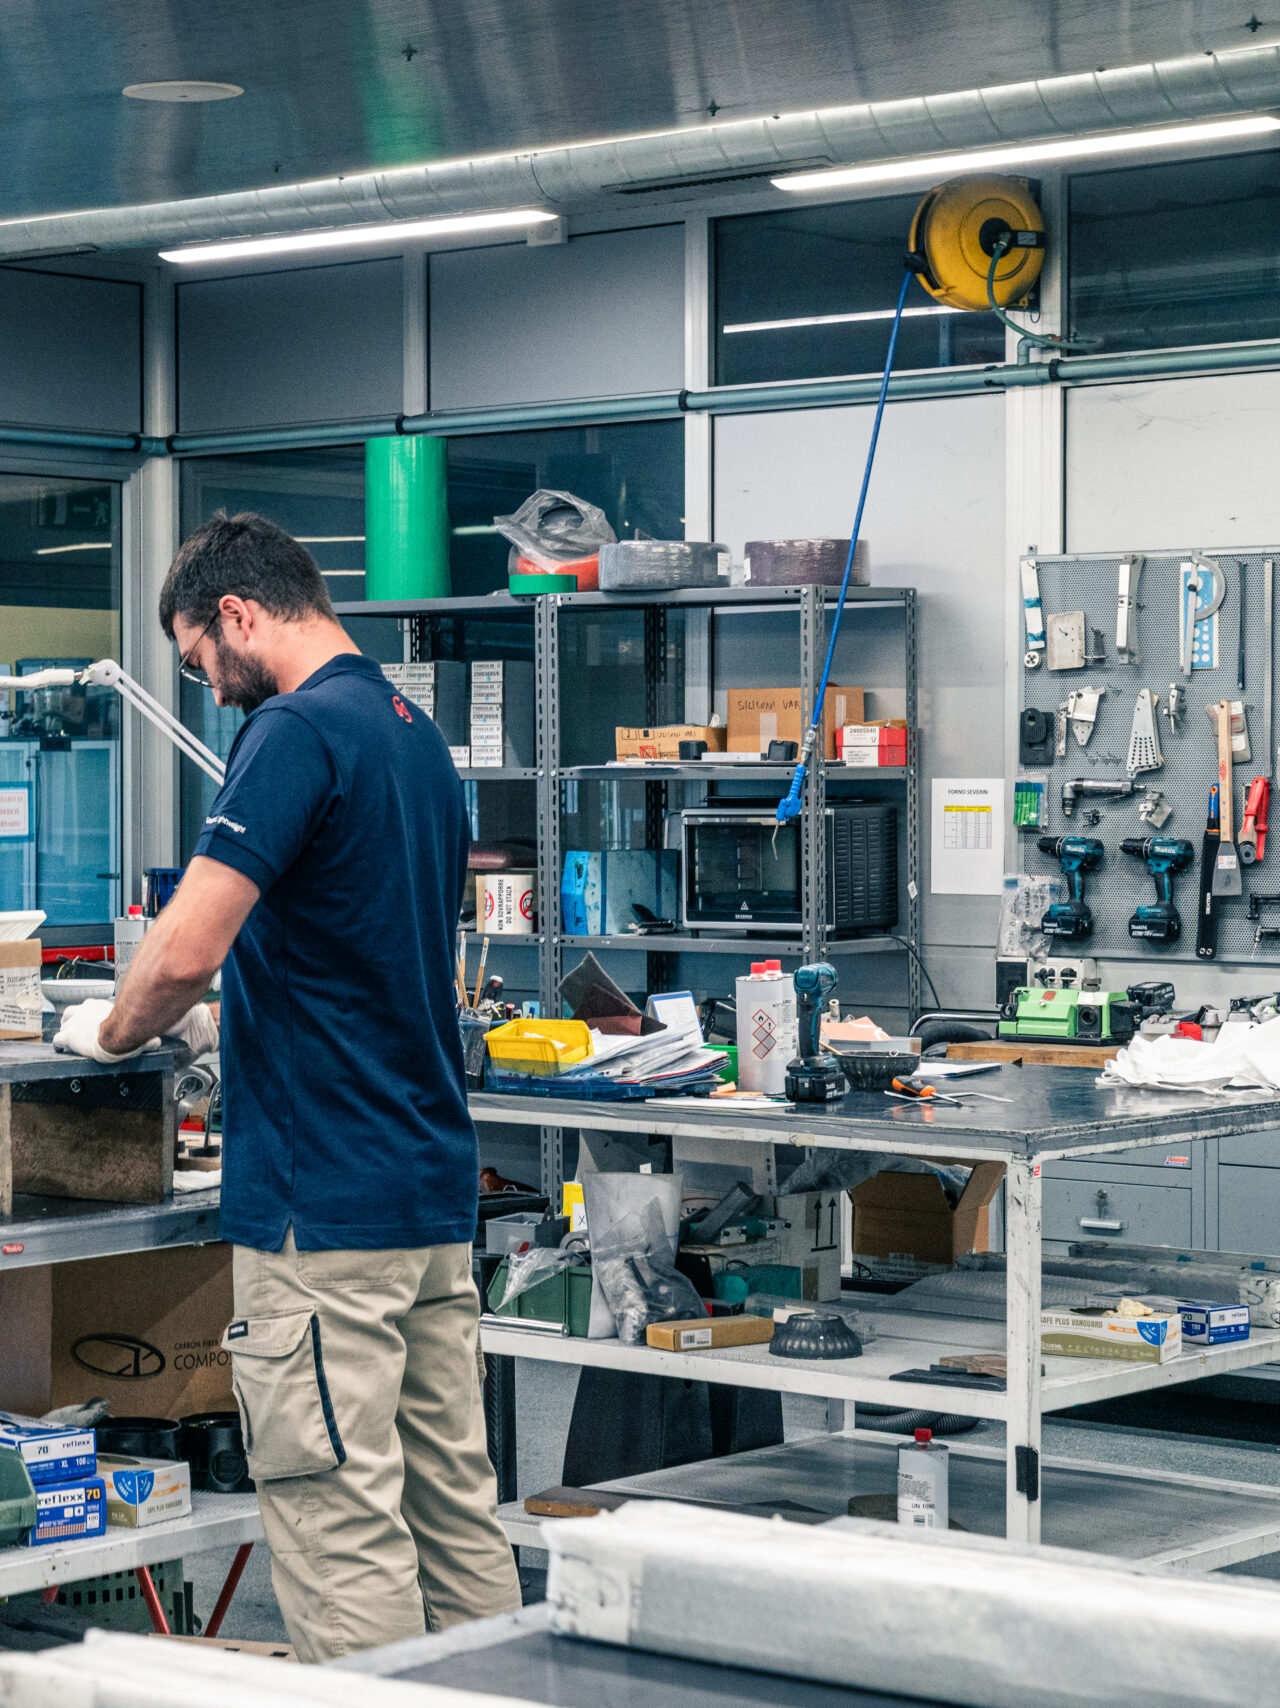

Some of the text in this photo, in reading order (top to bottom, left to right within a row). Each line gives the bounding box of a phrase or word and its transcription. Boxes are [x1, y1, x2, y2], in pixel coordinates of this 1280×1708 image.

[174, 1340, 201, 1350] CARBON
[37, 1439, 91, 1455] 70 reflexx
[38, 1487, 101, 1506] reflexx 70
